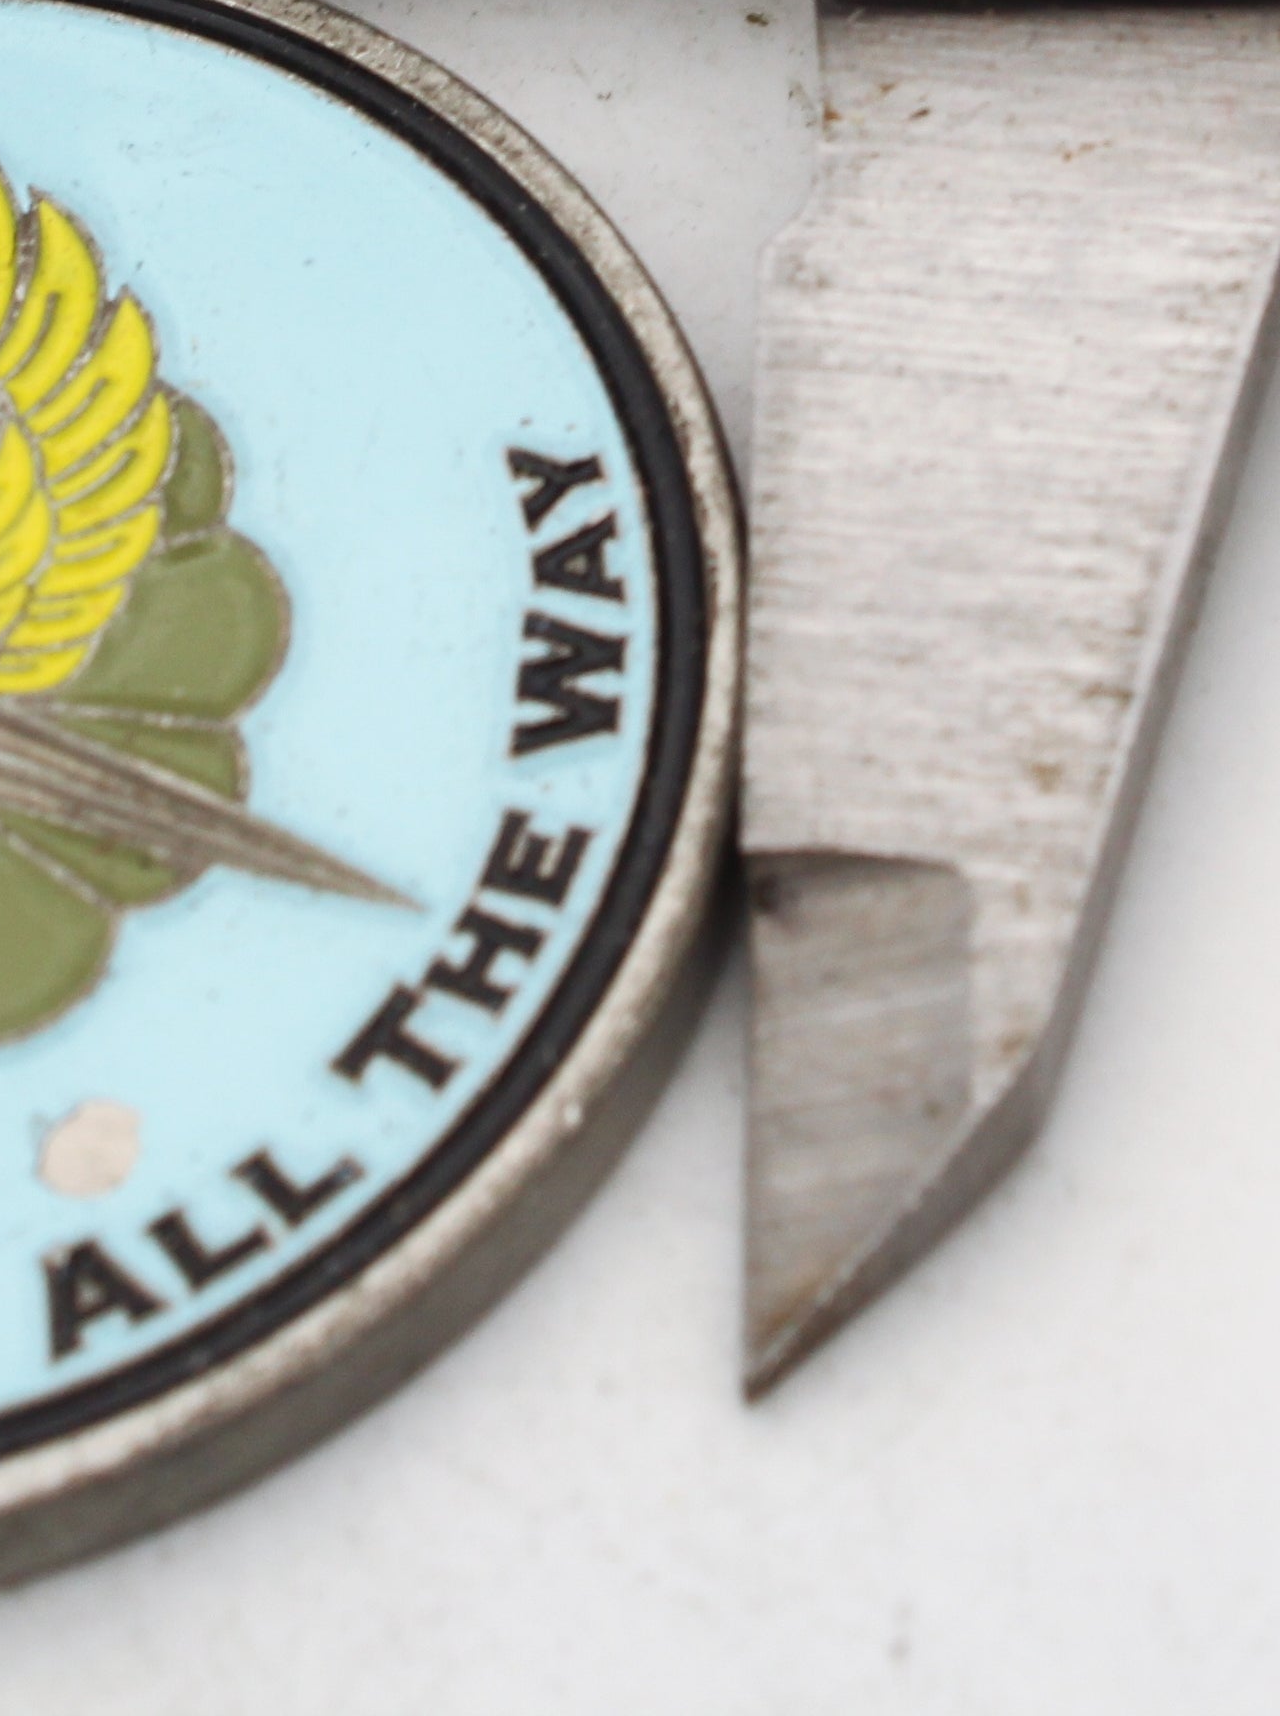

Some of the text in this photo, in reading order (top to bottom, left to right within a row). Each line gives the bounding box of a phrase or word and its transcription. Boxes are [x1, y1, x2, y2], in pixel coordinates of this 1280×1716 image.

[40, 444, 626, 1361] ALL THE WAY
